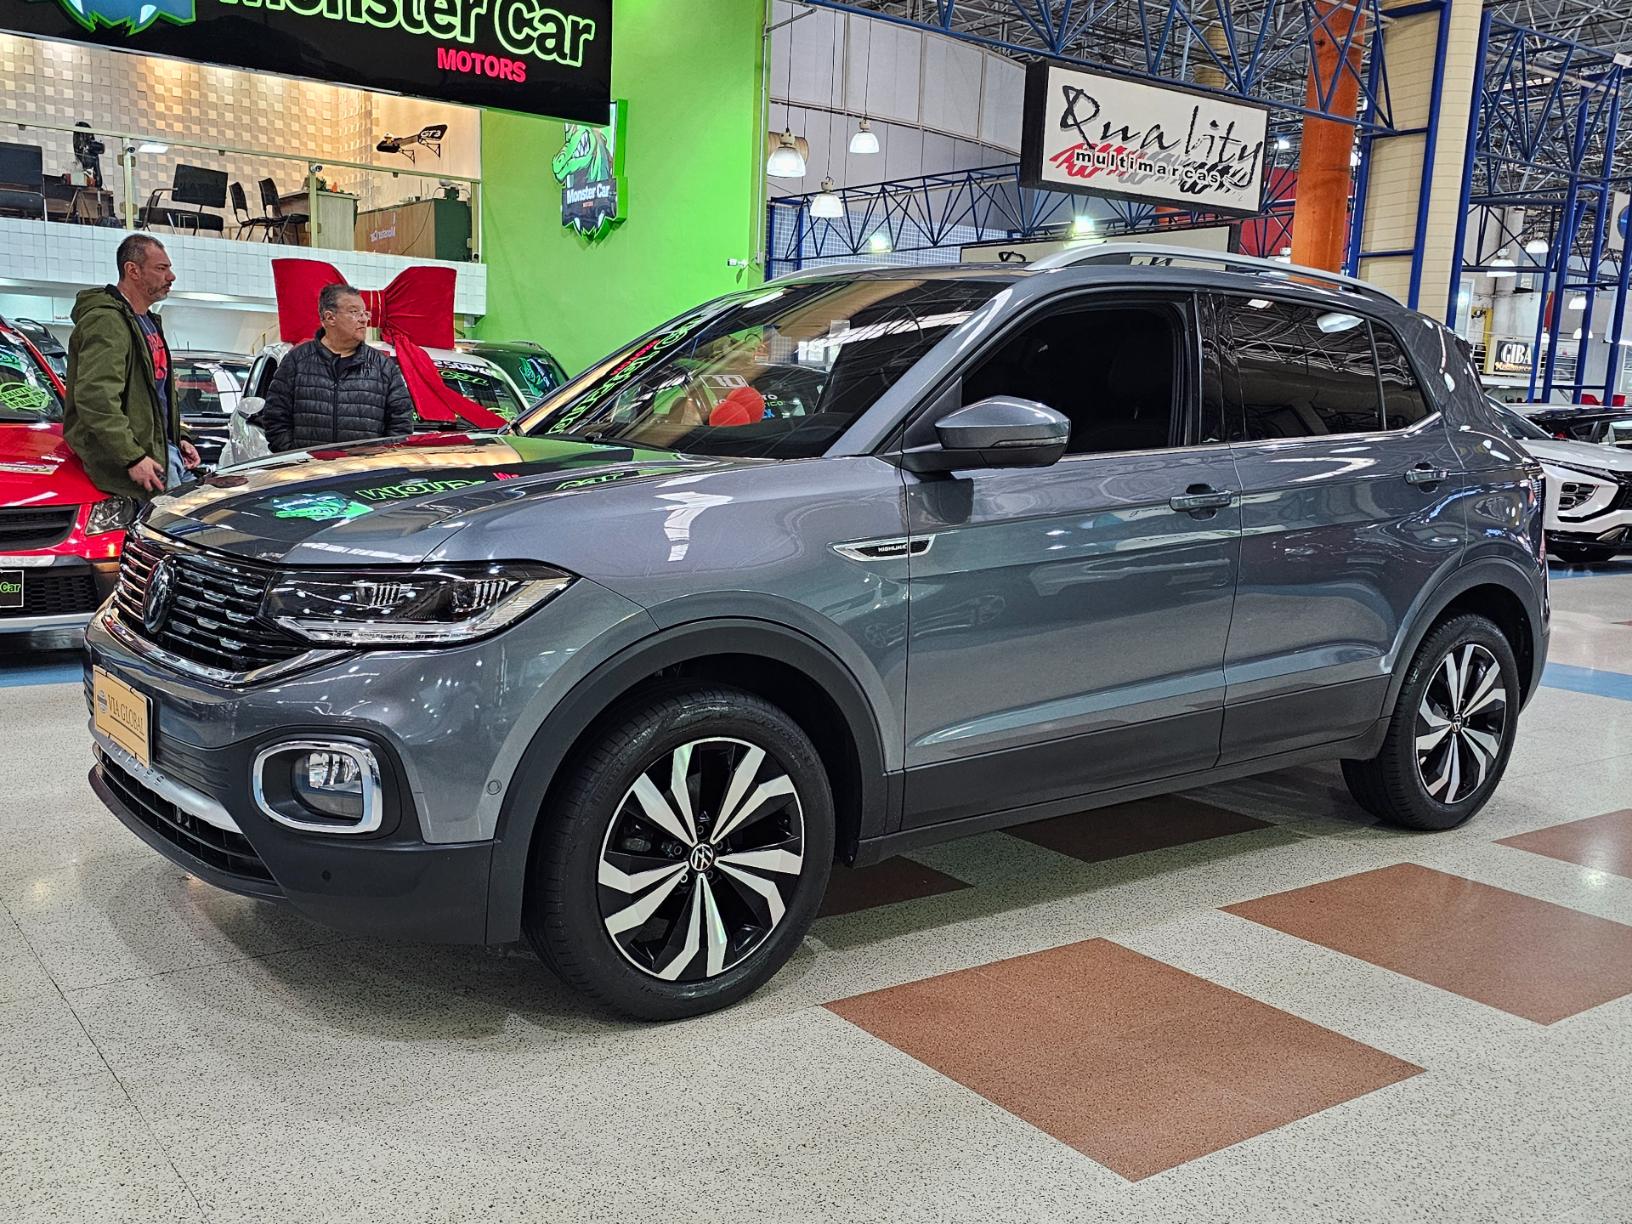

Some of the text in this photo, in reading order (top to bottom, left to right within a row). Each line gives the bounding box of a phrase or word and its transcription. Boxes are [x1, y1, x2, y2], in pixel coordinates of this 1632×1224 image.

[494, 0, 595, 67] Car
[436, 47, 526, 83] MOTORS
[1060, 85, 1263, 188] Quality
[1074, 150, 1220, 185] multimarcas
[566, 183, 611, 205] Monster Car
[1500, 343, 1533, 364] GIBA
[0, 581, 22, 593] Car
[107, 694, 145, 737] VIA GLOBAL
